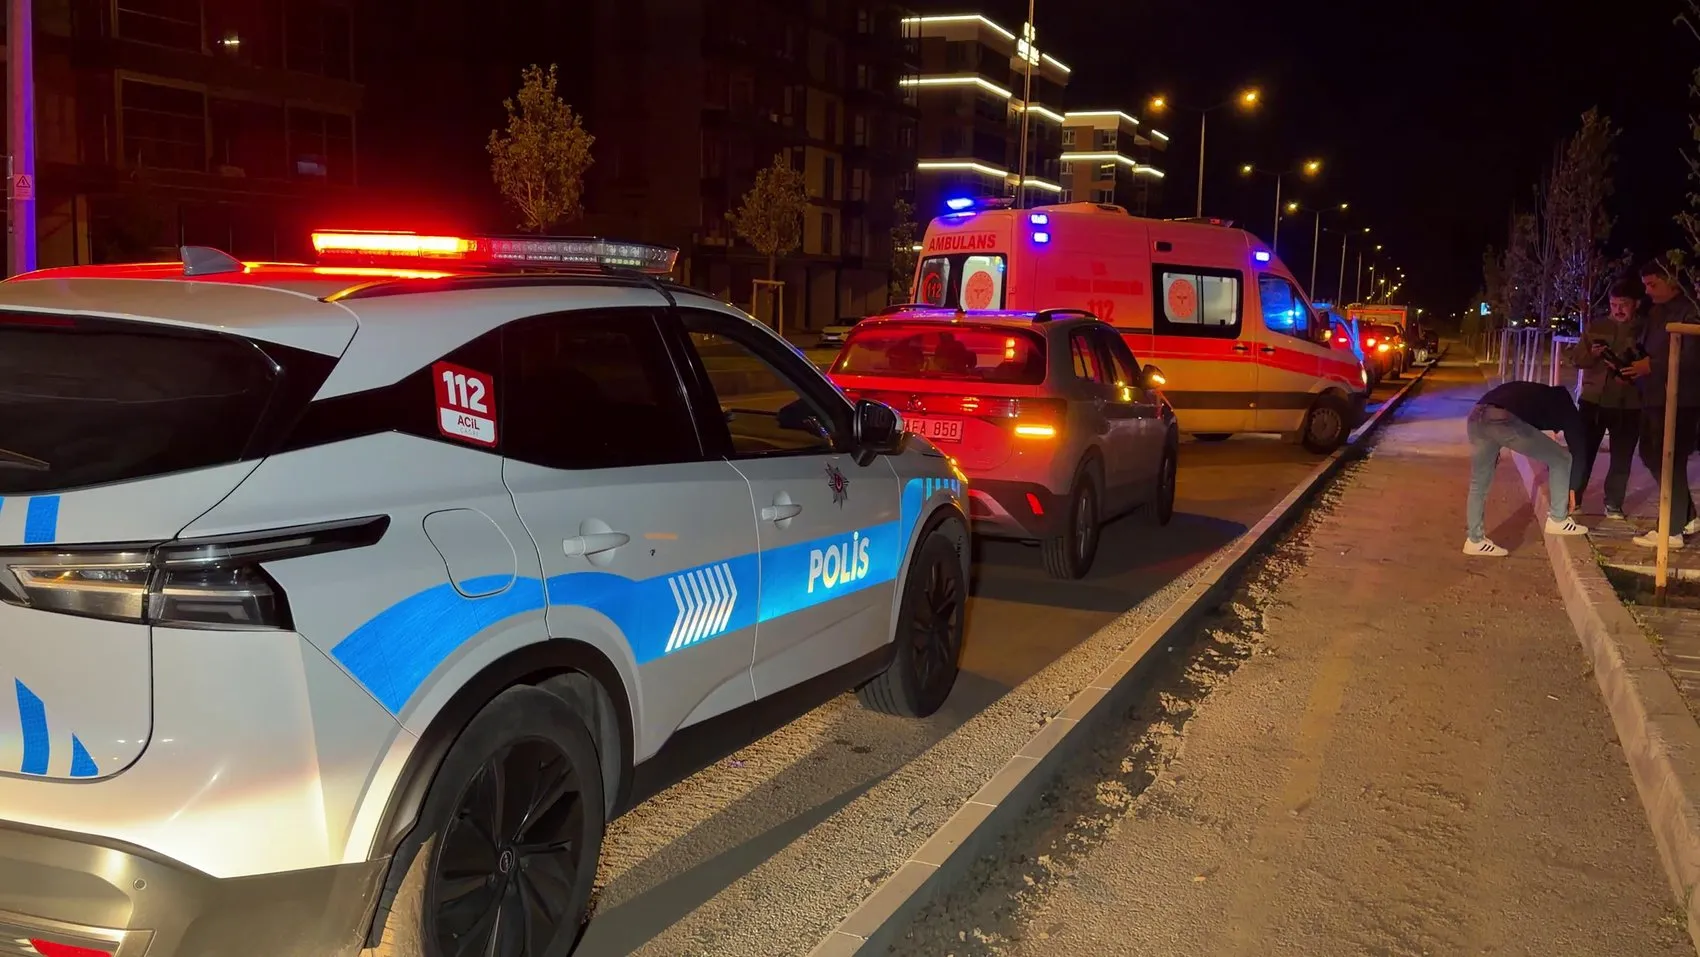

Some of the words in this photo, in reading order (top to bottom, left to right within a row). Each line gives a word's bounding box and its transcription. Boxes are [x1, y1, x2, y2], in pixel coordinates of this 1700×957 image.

[928, 234, 996, 252] AMBULANS
[927, 281, 943, 299] 112
[1087, 299, 1115, 323] 112
[442, 370, 488, 414] 112
[934, 421, 957, 437] 858
[807, 531, 870, 593] POLİS
